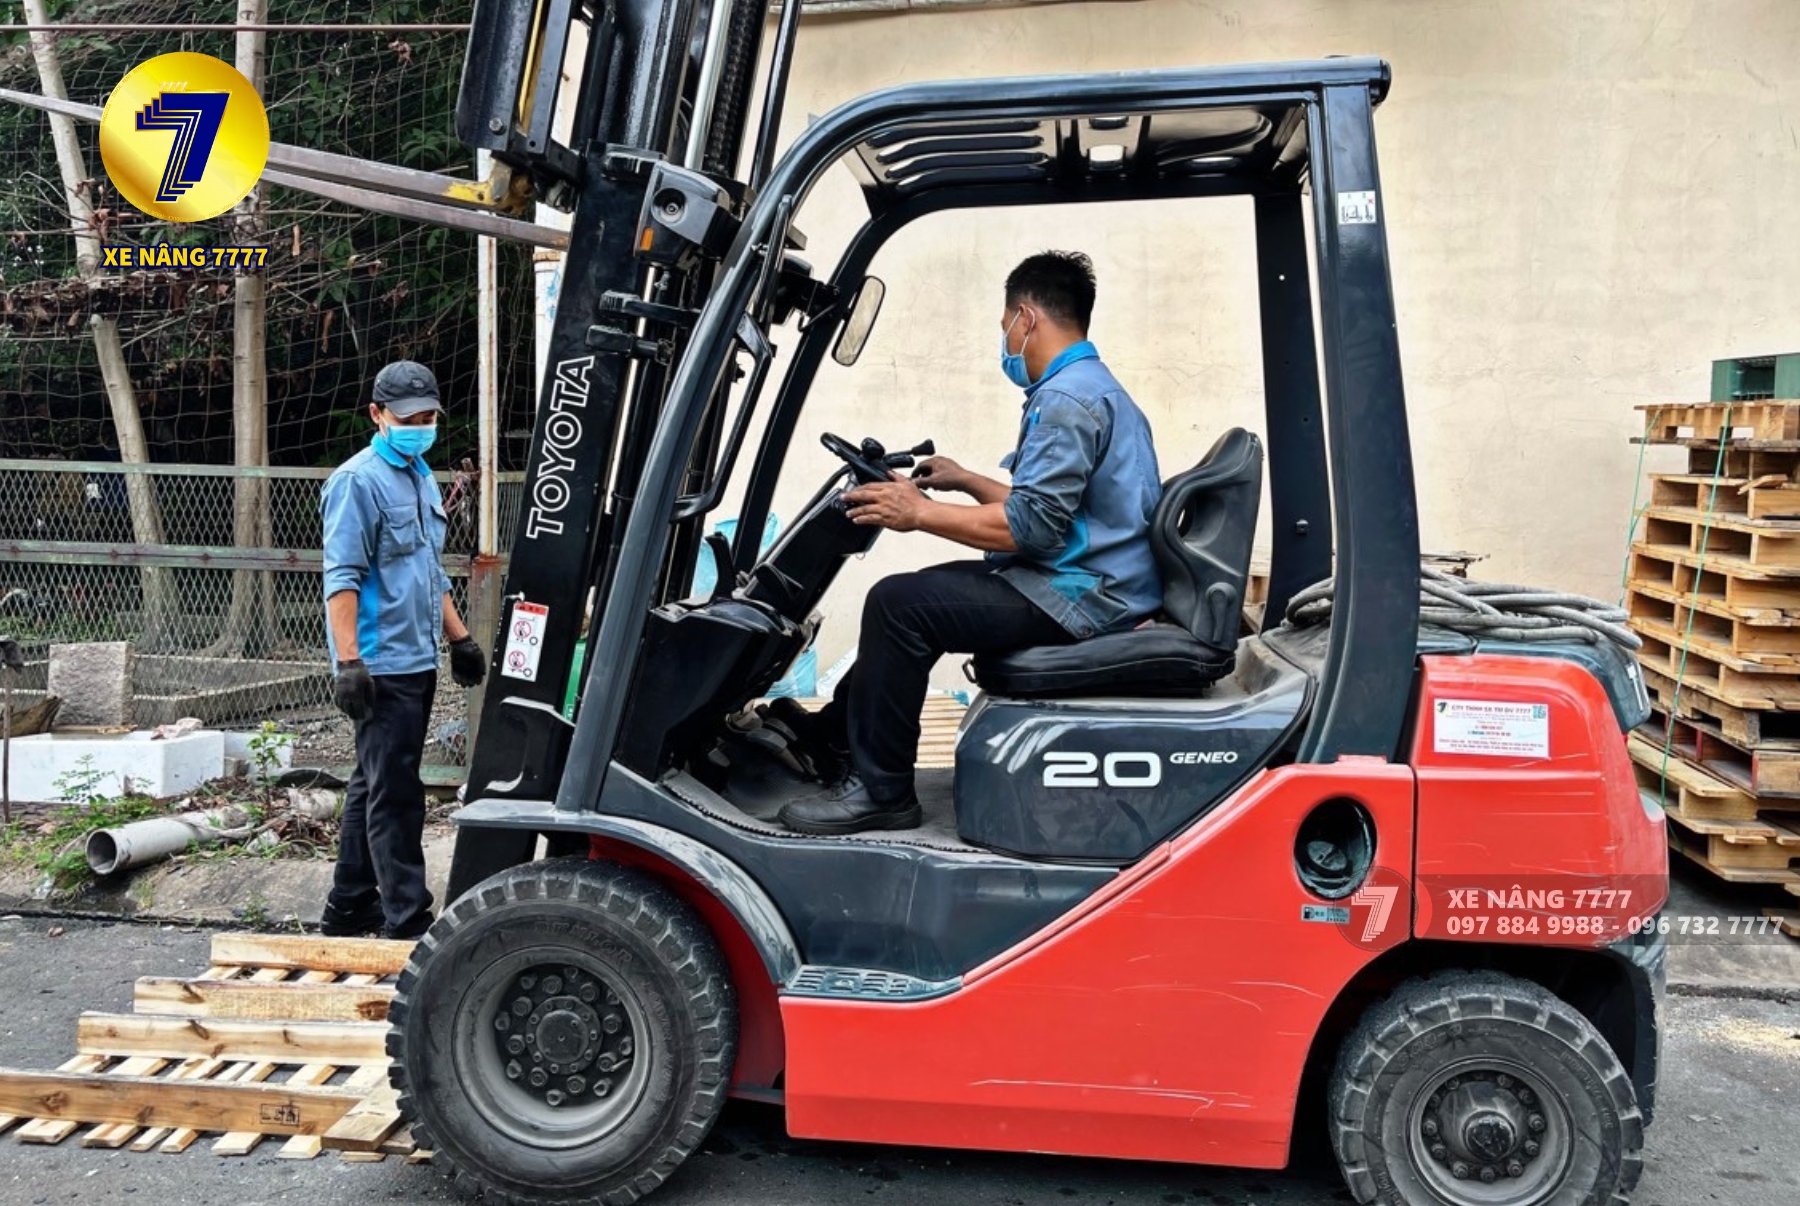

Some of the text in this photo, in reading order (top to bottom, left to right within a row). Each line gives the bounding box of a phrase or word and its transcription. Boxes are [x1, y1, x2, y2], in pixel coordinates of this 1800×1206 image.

[526, 355, 595, 539] TOYOTA
[1043, 751, 1238, 787] 20 GENEO
